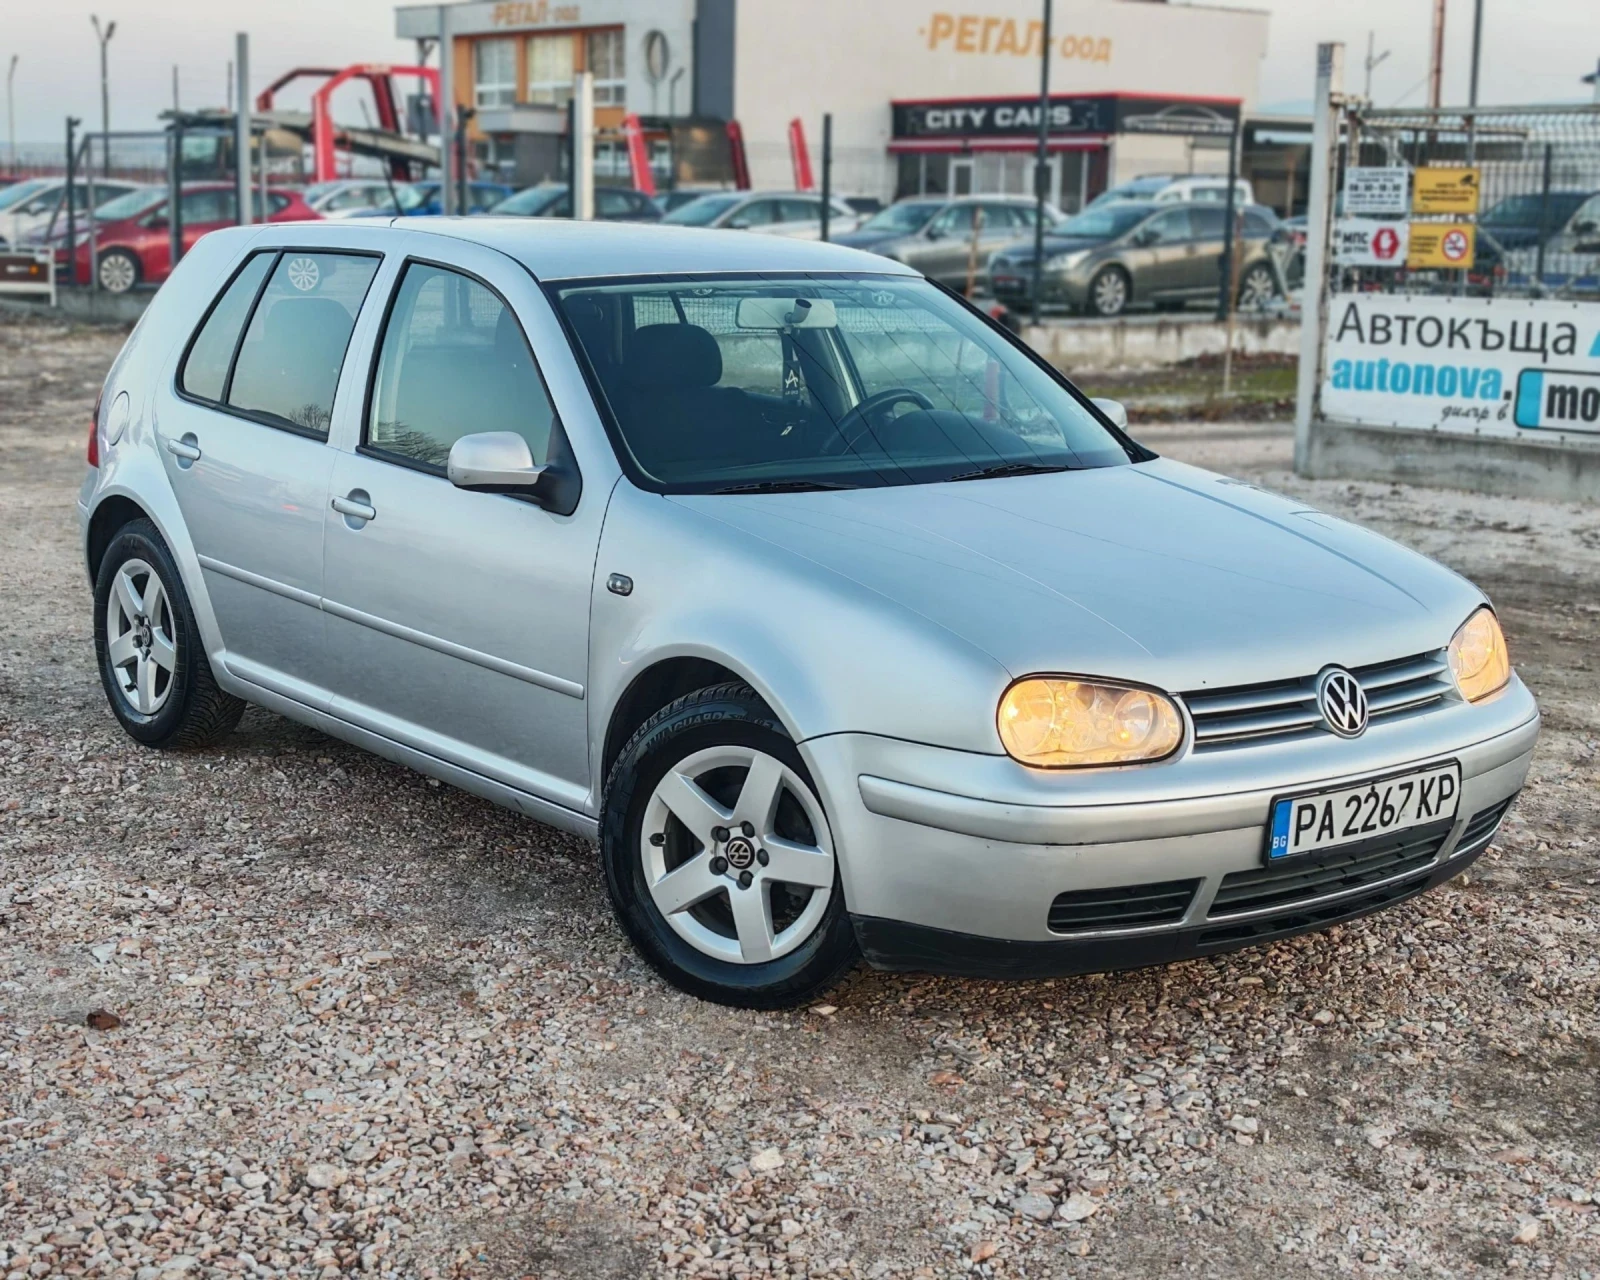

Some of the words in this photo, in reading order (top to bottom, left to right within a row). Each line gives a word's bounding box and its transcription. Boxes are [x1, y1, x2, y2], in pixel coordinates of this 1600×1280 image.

[925, 107, 986, 129] CITY
[1343, 232, 1369, 245] МПС
[1336, 301, 1577, 364] Автокъща
[1294, 799, 1334, 847] PA
[1342, 781, 1414, 837] 2267
[1416, 773, 1455, 820] KP
[1272, 835, 1287, 848] BG
